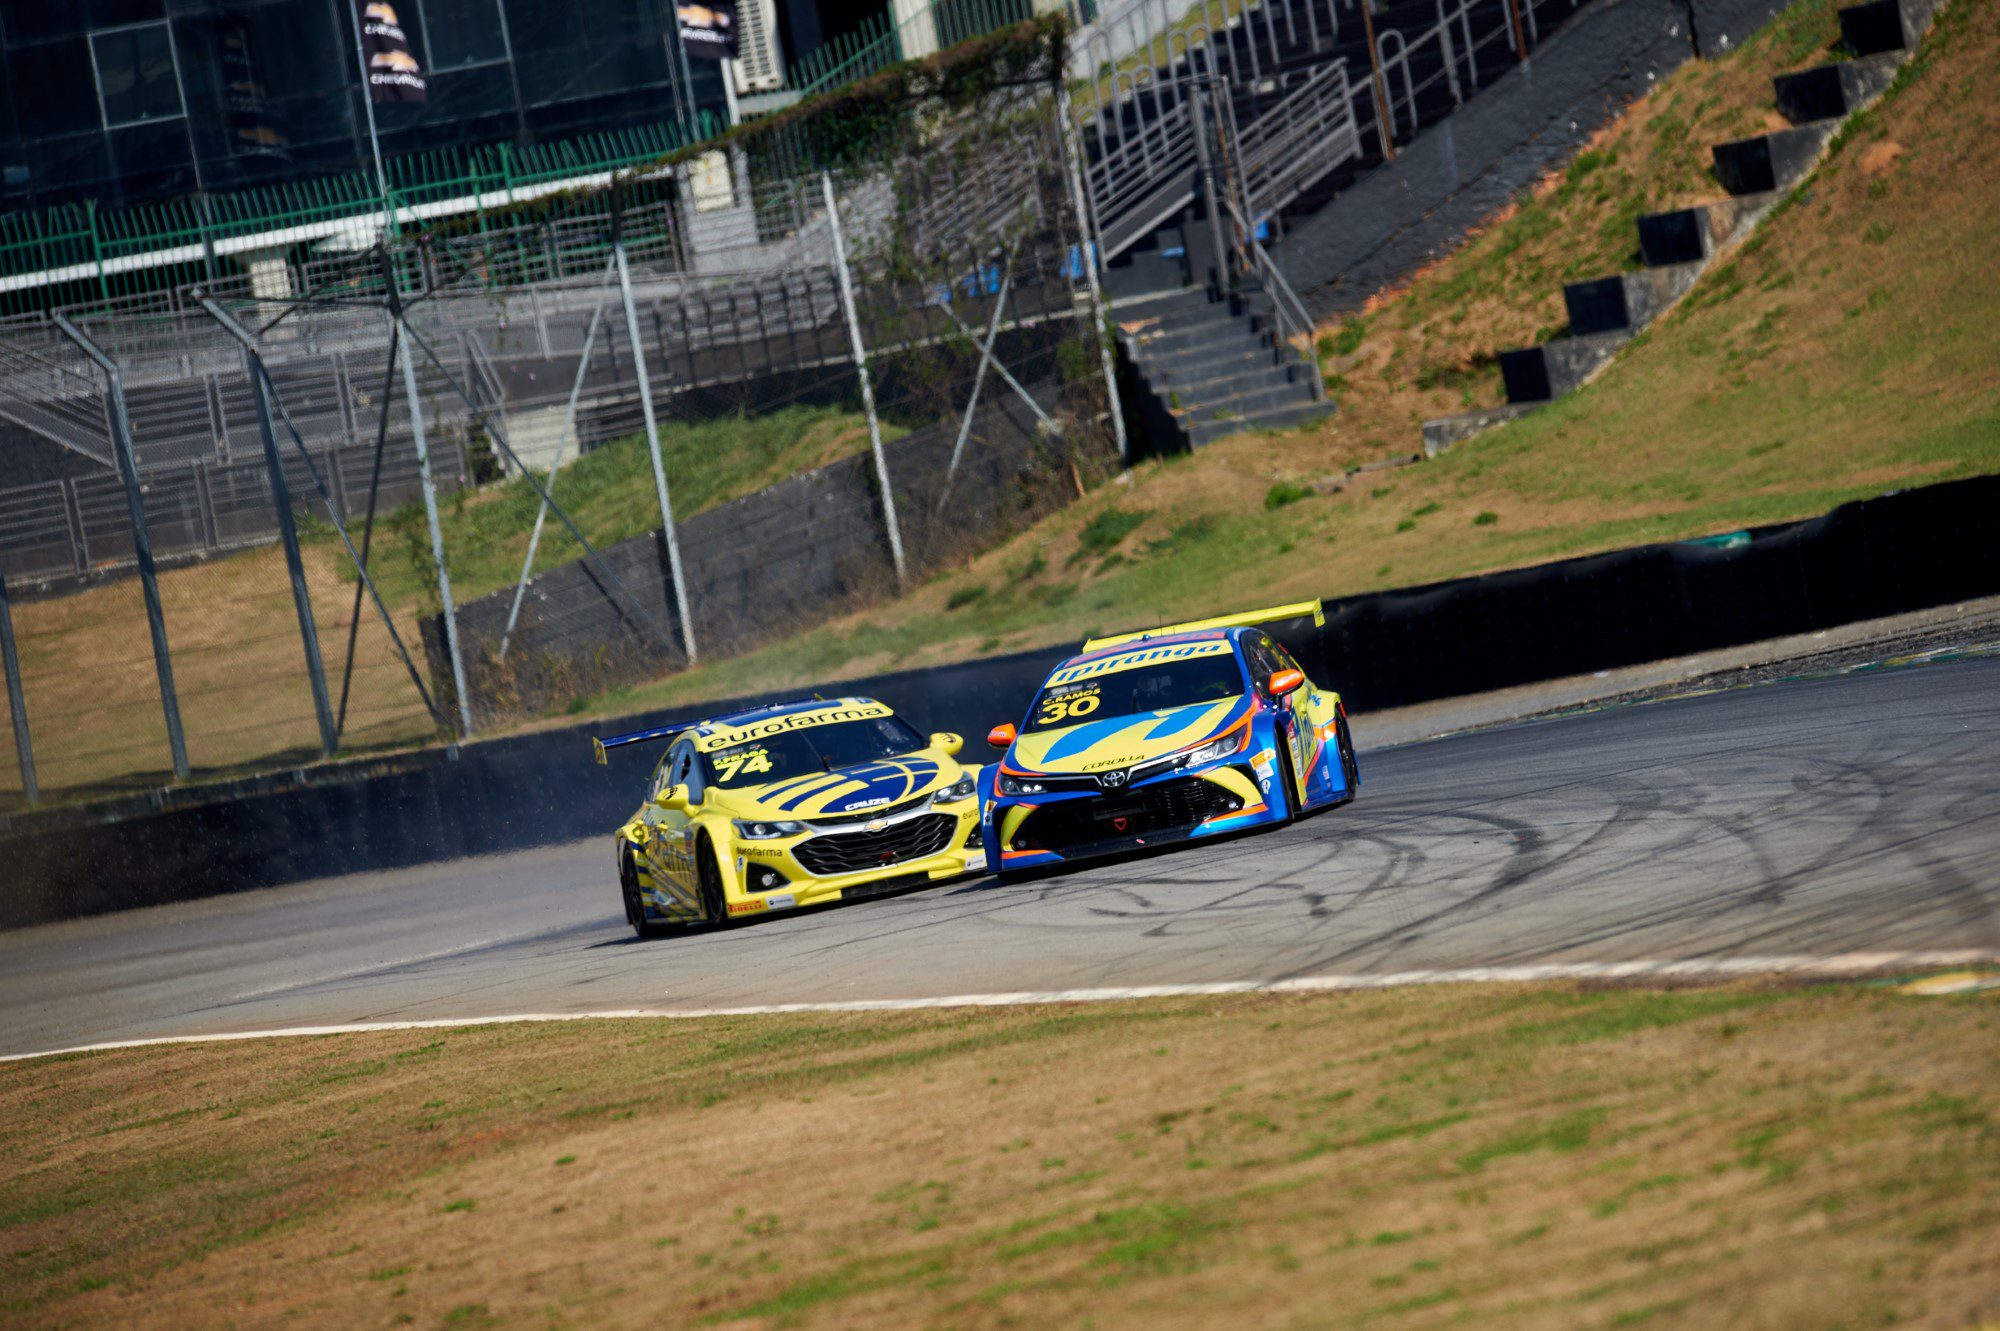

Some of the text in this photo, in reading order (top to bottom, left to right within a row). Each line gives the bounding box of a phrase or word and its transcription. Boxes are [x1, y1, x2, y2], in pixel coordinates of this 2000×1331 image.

[1042, 688, 1101, 706] C.RAMOS
[1038, 696, 1100, 724] 30
[707, 706, 884, 748] eurofarma
[715, 754, 773, 782] 74
[1082, 755, 1145, 771] COROLLA
[845, 797, 890, 811] CRUZE
